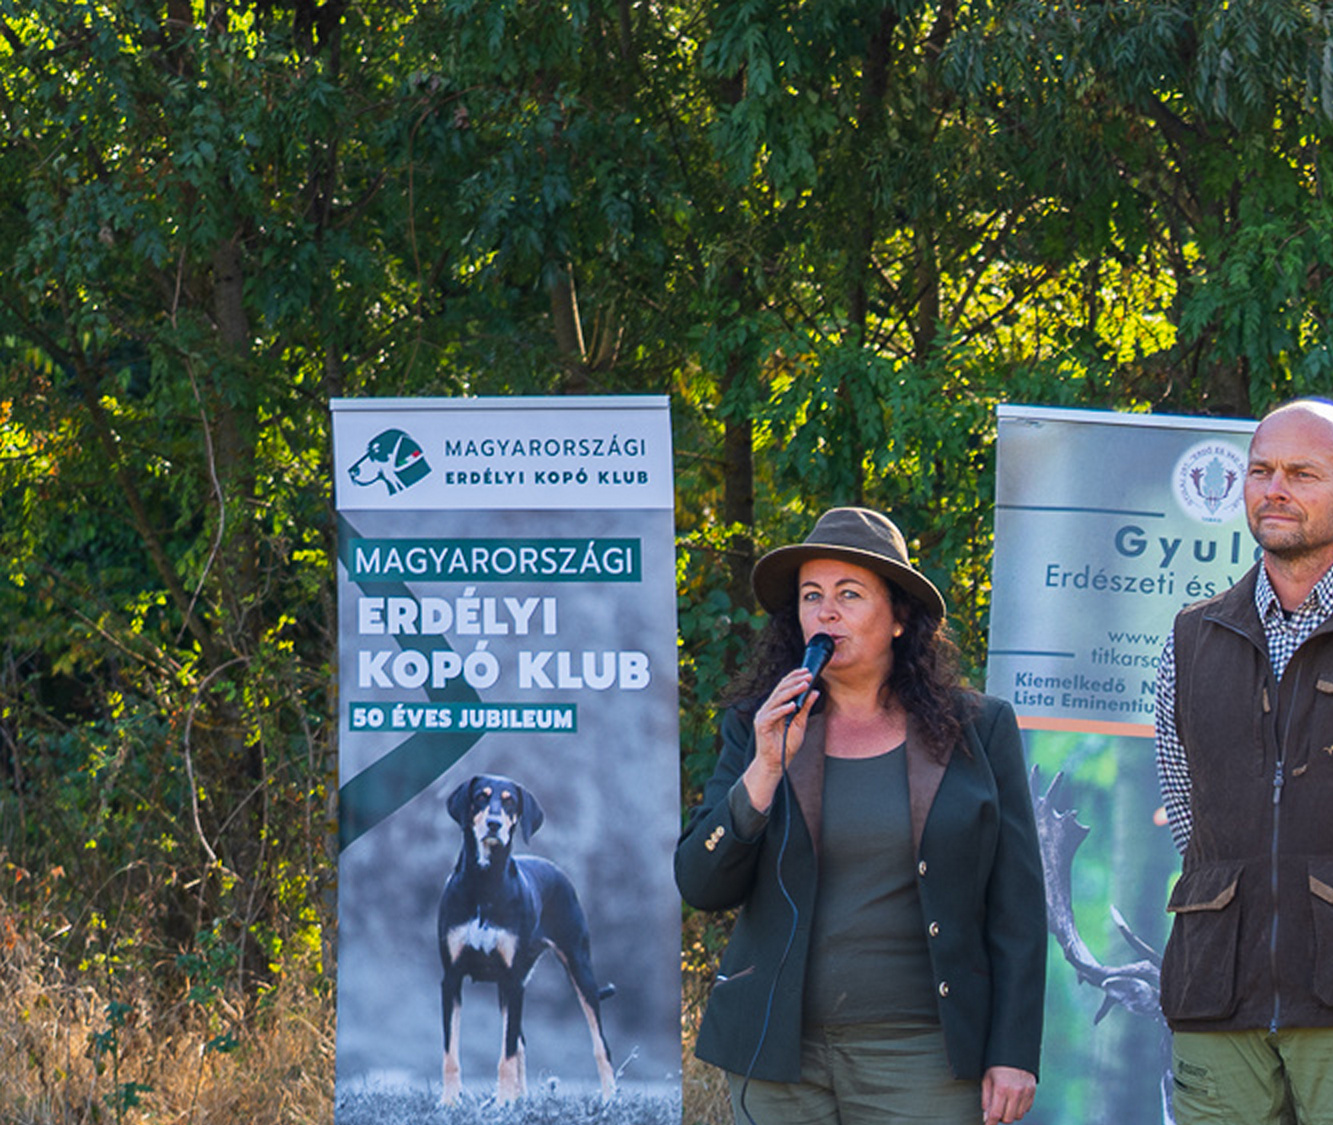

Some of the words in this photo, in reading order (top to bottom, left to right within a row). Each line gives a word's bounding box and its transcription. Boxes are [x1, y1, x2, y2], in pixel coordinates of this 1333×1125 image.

[445, 434, 646, 457] MAGYARORSZÁGI
[446, 467, 525, 485] ERDÉLYI
[535, 467, 588, 485] KOPÓ
[598, 471, 649, 485] KLUB
[355, 541, 633, 574] MAGYARORSZÁGI
[1045, 564, 1175, 595] Erdészeti
[1185, 570, 1216, 598] és
[358, 586, 557, 635] ERDÉLYI
[358, 640, 500, 690] KOPÓ
[518, 651, 651, 690] KLUB
[1015, 672, 1126, 694] Kiemelkedő
[1014, 691, 1055, 707] Lista
[353, 708, 384, 728] 50
[392, 704, 452, 728] ÉVES
[458, 709, 573, 729] JUBILEUM
